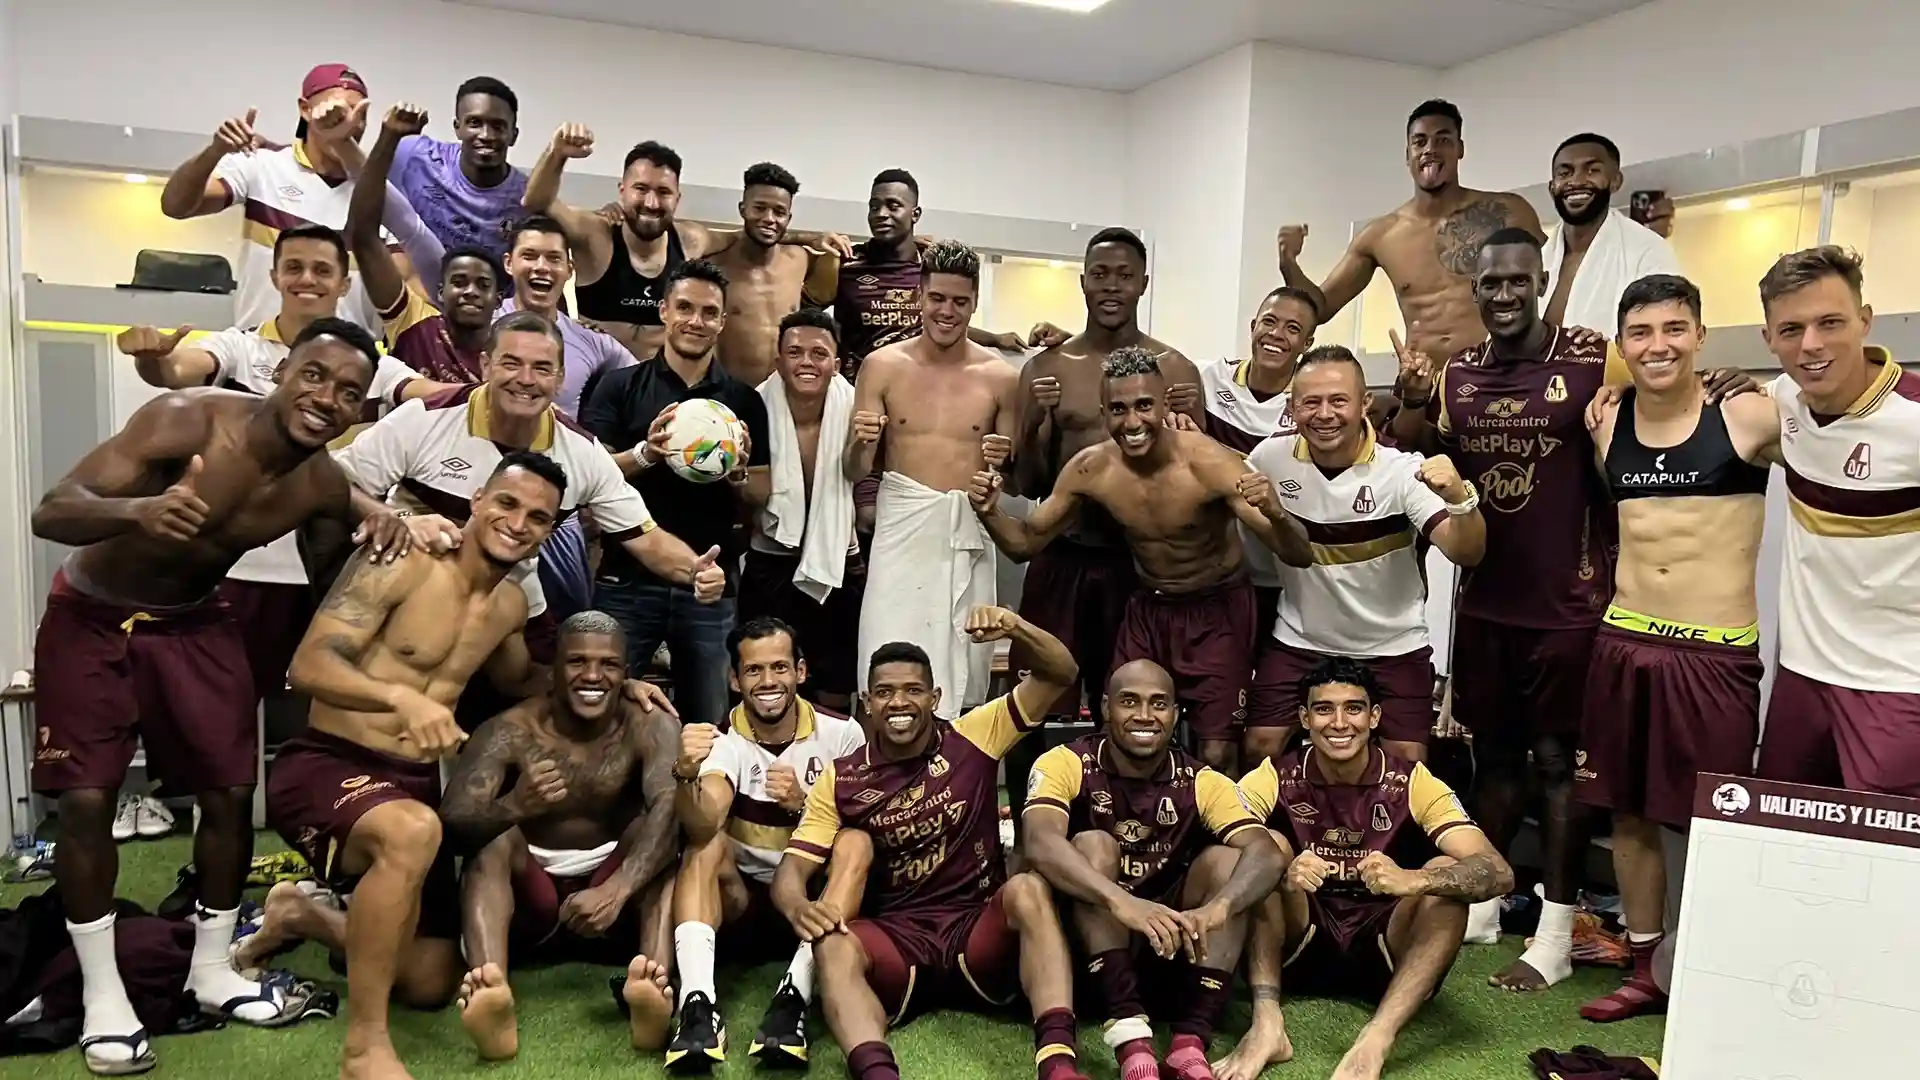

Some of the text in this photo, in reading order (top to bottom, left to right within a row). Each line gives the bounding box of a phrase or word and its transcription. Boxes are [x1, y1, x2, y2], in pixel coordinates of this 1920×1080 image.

[620, 298, 662, 308] CATAPU
[1467, 415, 1549, 428] Mercacentro
[1461, 433, 1535, 458] BetPlay
[1479, 462, 1535, 504] Pool
[1621, 471, 1699, 484] CATAPULT
[1648, 621, 1709, 641] NIKE
[1238, 688, 1247, 707] 6
[869, 786, 952, 827] Mercacentro
[1760, 794, 1847, 823] VALIENTES
[1850, 805, 1865, 825] Y
